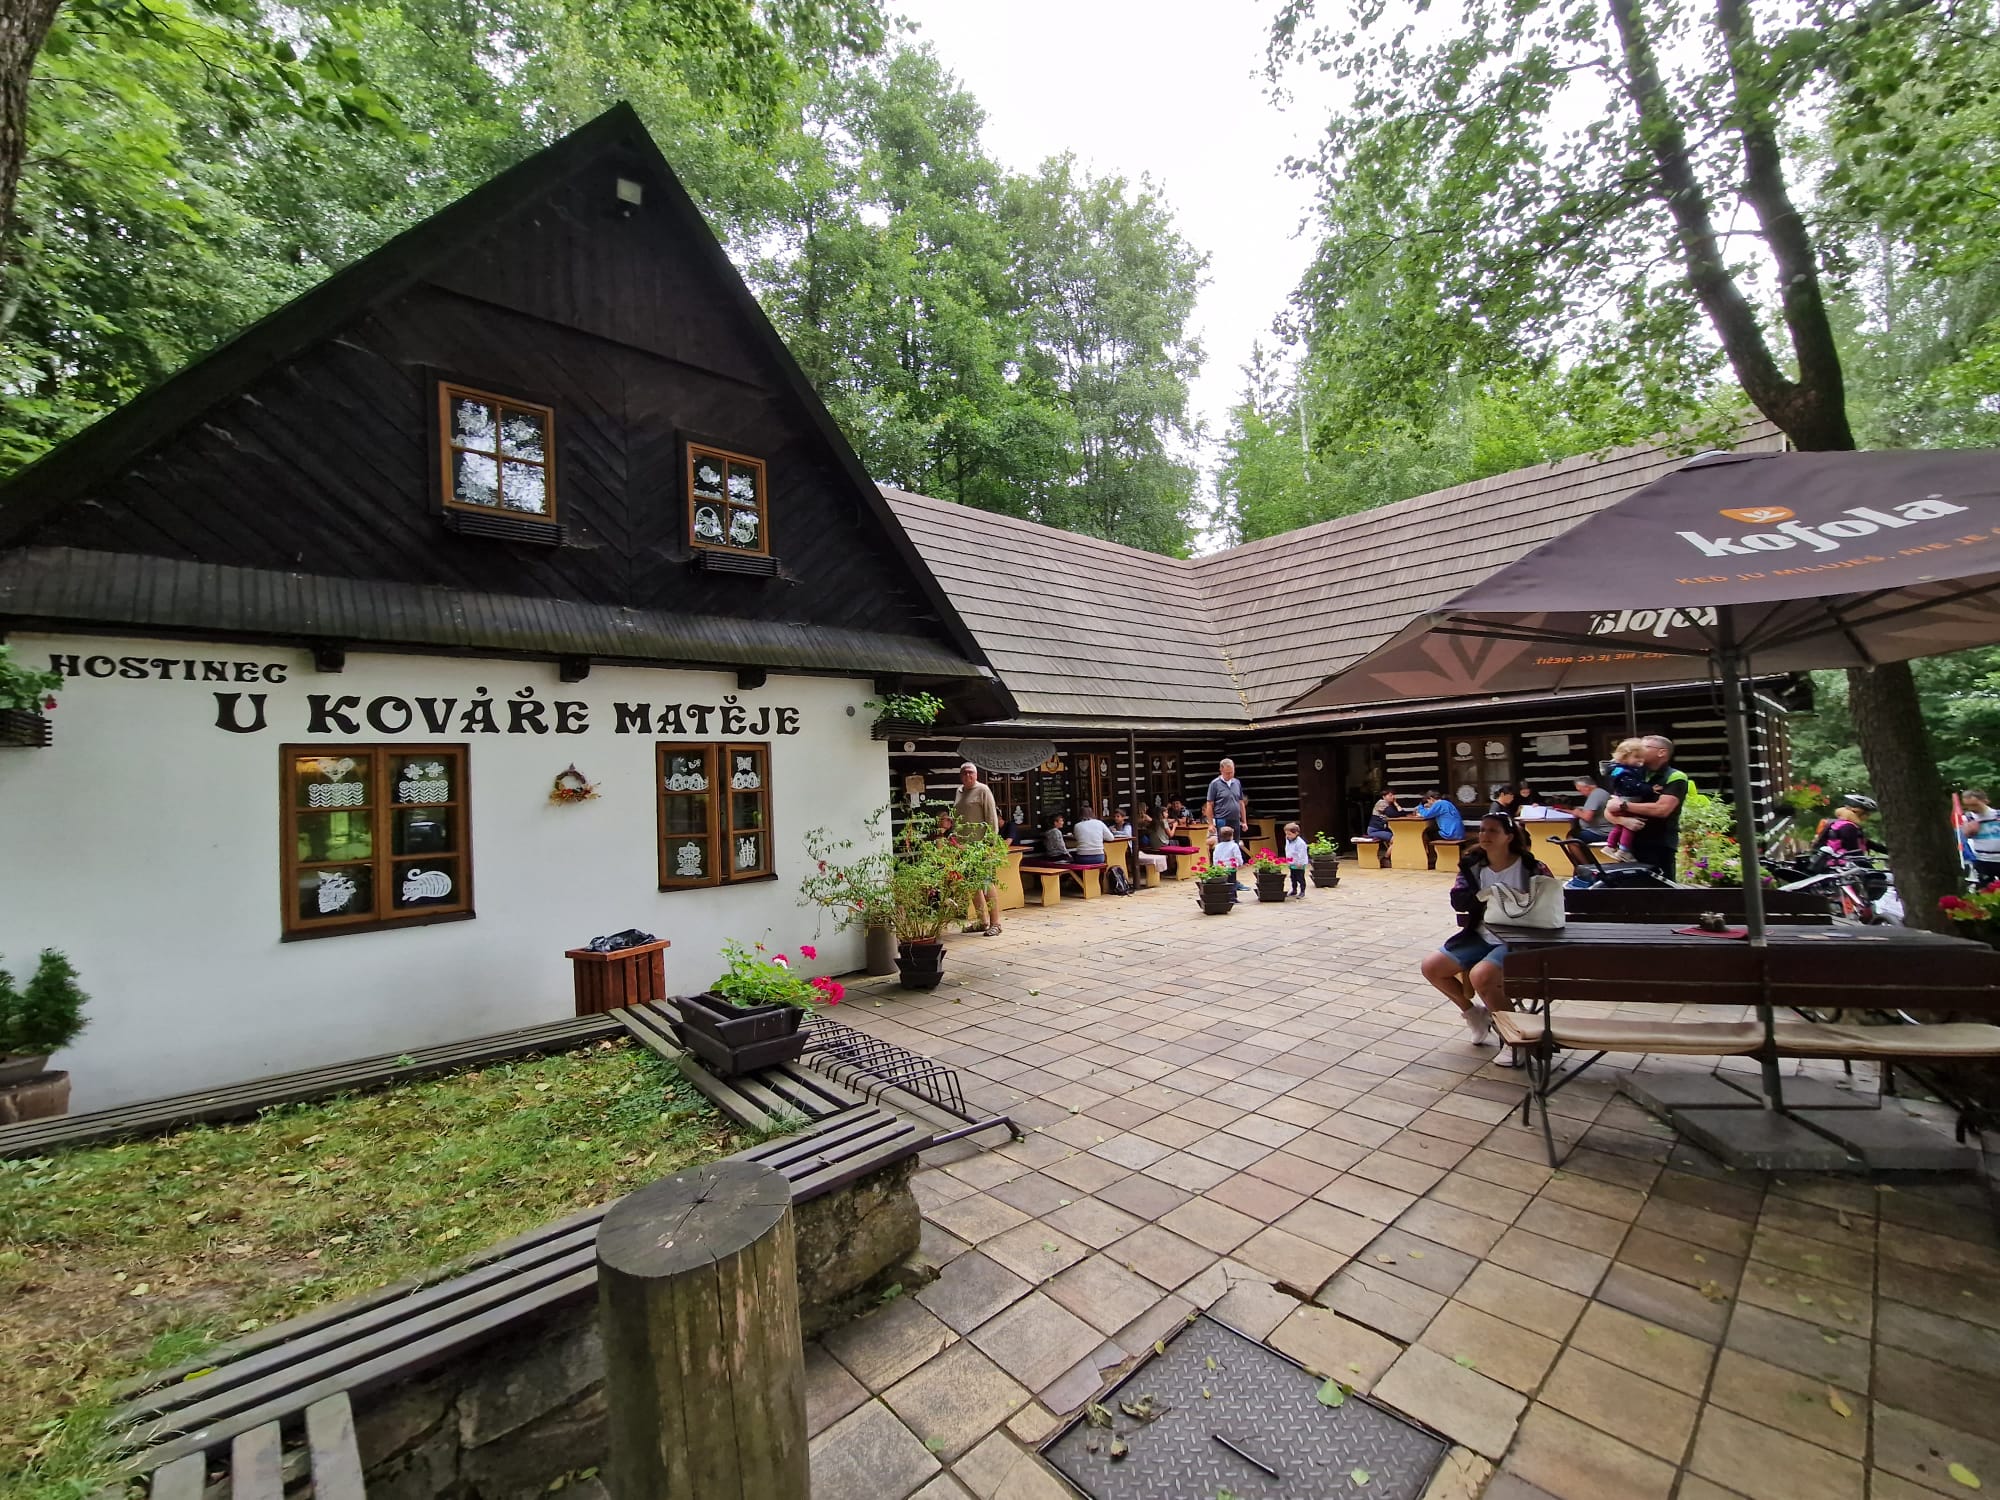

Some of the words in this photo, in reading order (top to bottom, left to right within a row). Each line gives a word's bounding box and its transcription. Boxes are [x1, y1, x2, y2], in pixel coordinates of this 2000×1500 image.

[1675, 498, 1969, 557] kofola
[49, 654, 288, 684] HOSTINEC
[213, 692, 268, 733] U
[306, 686, 590, 735] KOVÁŘE
[613, 695, 800, 735] MATĚJE
